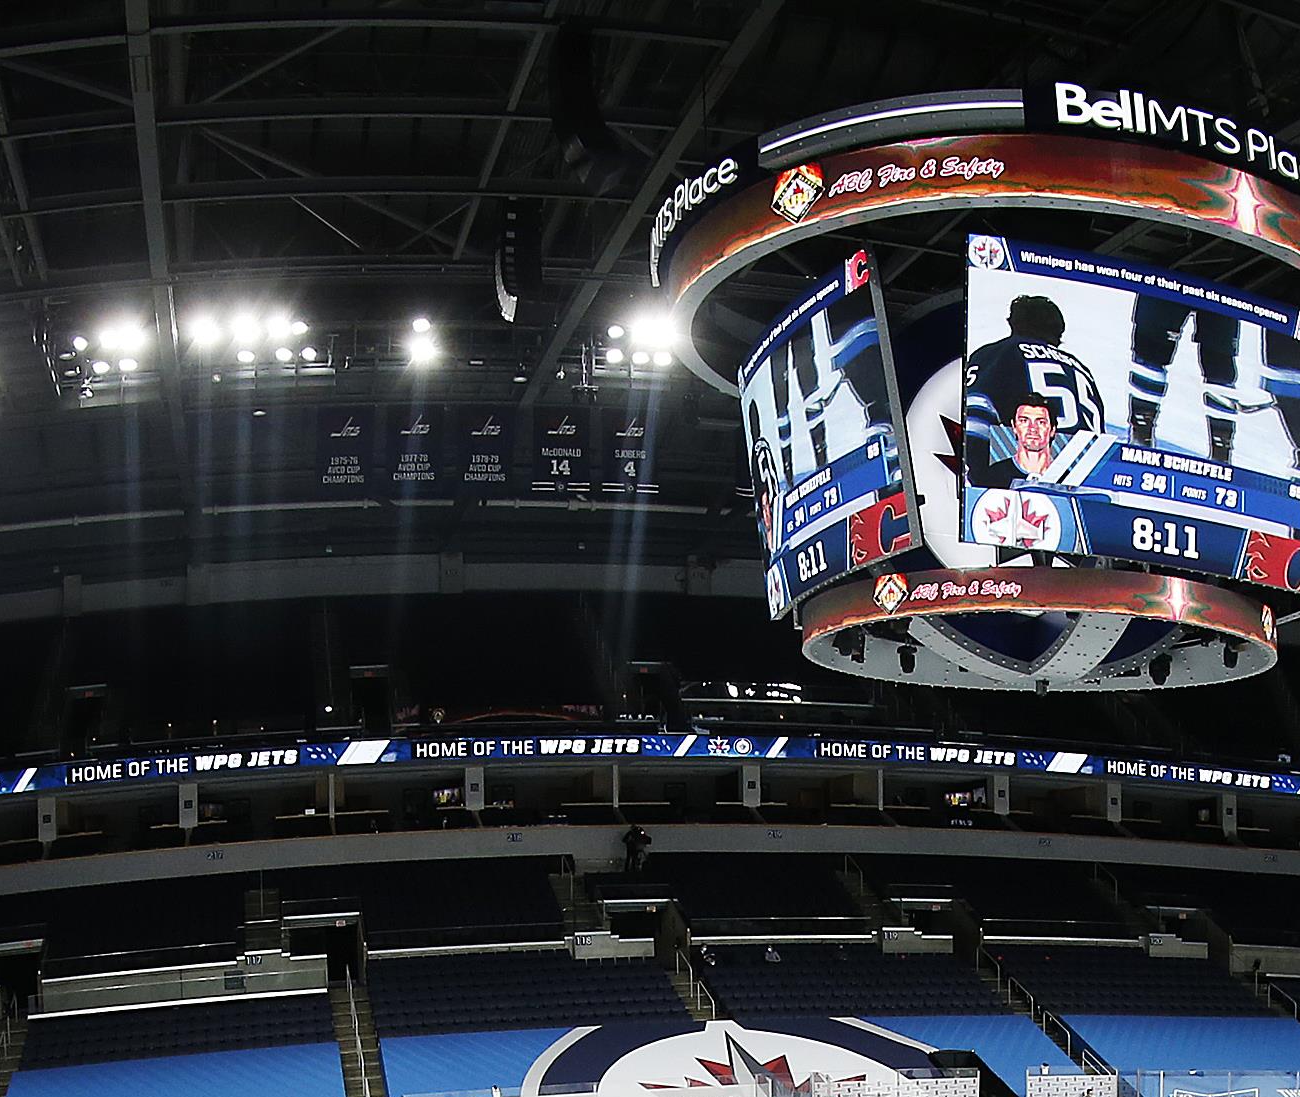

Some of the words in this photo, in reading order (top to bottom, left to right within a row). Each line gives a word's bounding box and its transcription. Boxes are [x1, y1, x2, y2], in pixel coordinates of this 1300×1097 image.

[674, 157, 739, 221] Place
[829, 168, 872, 197] ABC
[878, 164, 915, 187] Fire
[921, 160, 936, 177] &
[940, 157, 1004, 179] Safety
[1020, 250, 1073, 271] Winnipeg
[1075, 259, 1095, 273] has
[1121, 269, 1143, 282] four
[1144, 275, 1155, 285] of
[1157, 277, 1182, 292] their
[1183, 284, 1204, 298] past
[1206, 291, 1220, 302] six
[1254, 304, 1288, 323] openers
[392, 471, 436, 481] CHAMPIONS
[463, 472, 506, 482] CHAMPIONS
[550, 459, 571, 475] 14
[623, 461, 636, 477] 4
[1121, 446, 1162, 467] MARK
[1163, 453, 1233, 482] SCHEIFELE
[322, 474, 365, 484] CHAMPIONS
[1112, 473, 1133, 487] HITS
[1140, 472, 1167, 494] 34
[1215, 487, 1238, 508] 73
[1132, 516, 1199, 560] 8:11
[797, 540, 828, 582] 8:11
[416, 741, 468, 758] HOME
[473, 740, 496, 756] OF
[500, 739, 534, 755] THE
[539, 739, 587, 755] WPG
[590, 738, 640, 754] JETS
[820, 742, 867, 758] HOME
[871, 744, 892, 759] OF
[895, 745, 925, 761] THE
[929, 746, 970, 763] WPG
[973, 749, 1016, 766] JETS
[71, 763, 122, 783] HOME
[128, 760, 151, 777] OF
[155, 757, 189, 775] THE
[194, 752, 243, 771] WPG
[246, 749, 298, 768] JETS
[1107, 760, 1147, 777] HOME
[1150, 764, 1168, 778] OF
[1169, 765, 1195, 782] THE
[1198, 768, 1233, 785] WPG
[1234, 773, 1271, 789] JETS
[575, 936, 592, 945] 118
